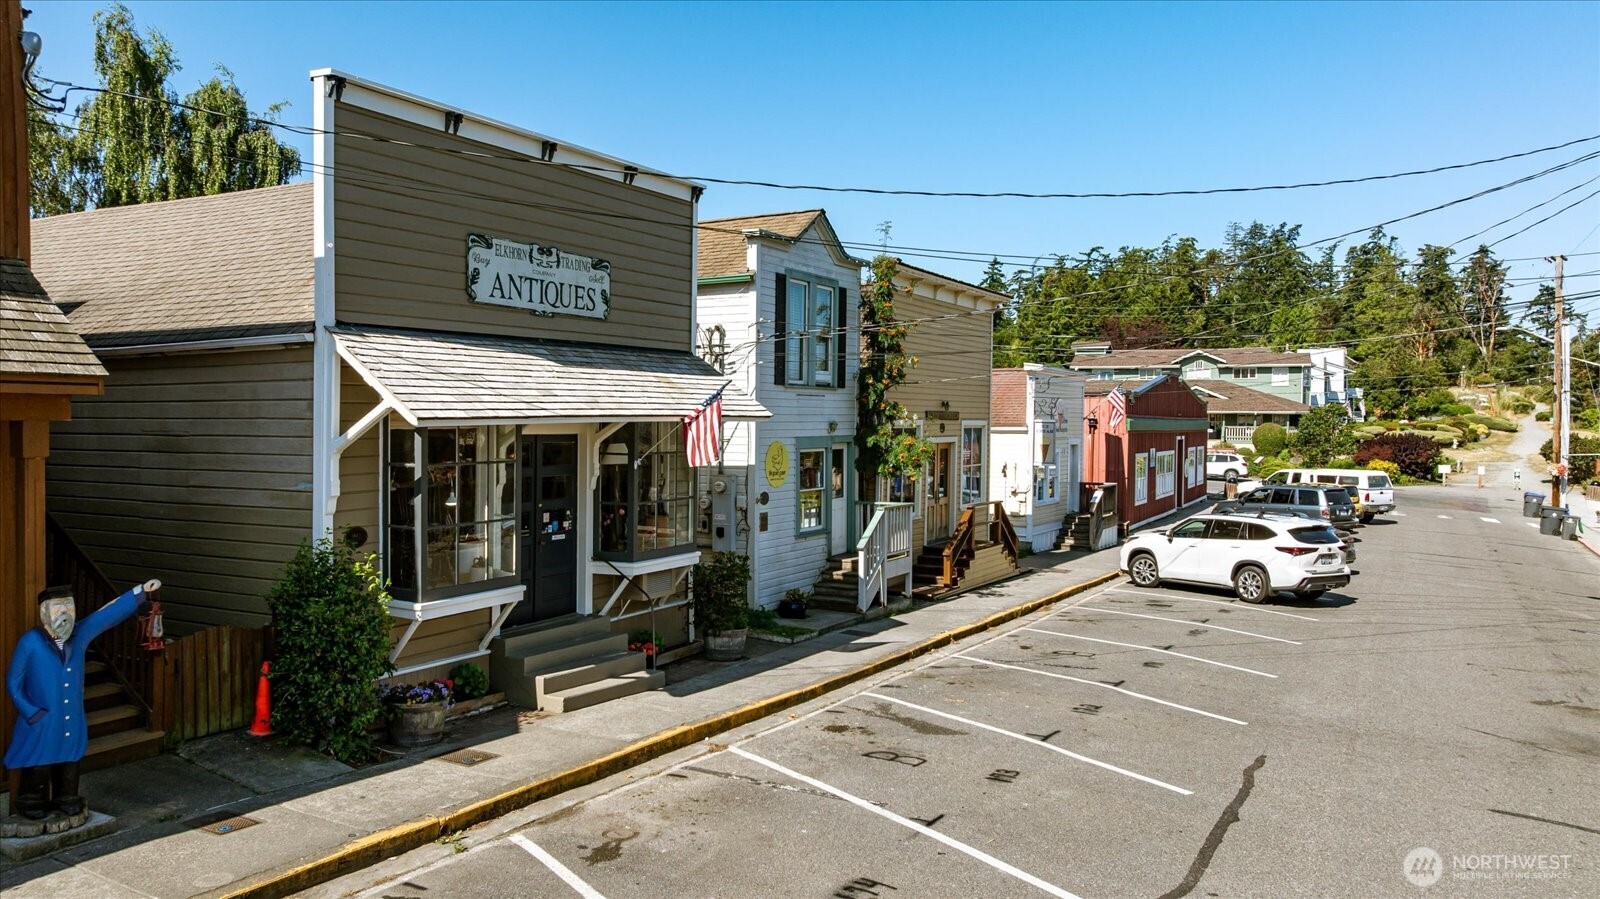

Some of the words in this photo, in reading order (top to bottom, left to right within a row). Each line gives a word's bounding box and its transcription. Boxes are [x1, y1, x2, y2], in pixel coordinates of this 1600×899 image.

[494, 244, 529, 261] ELKHORN
[561, 256, 591, 273] TRADING
[489, 272, 596, 312] ANTIQUES
